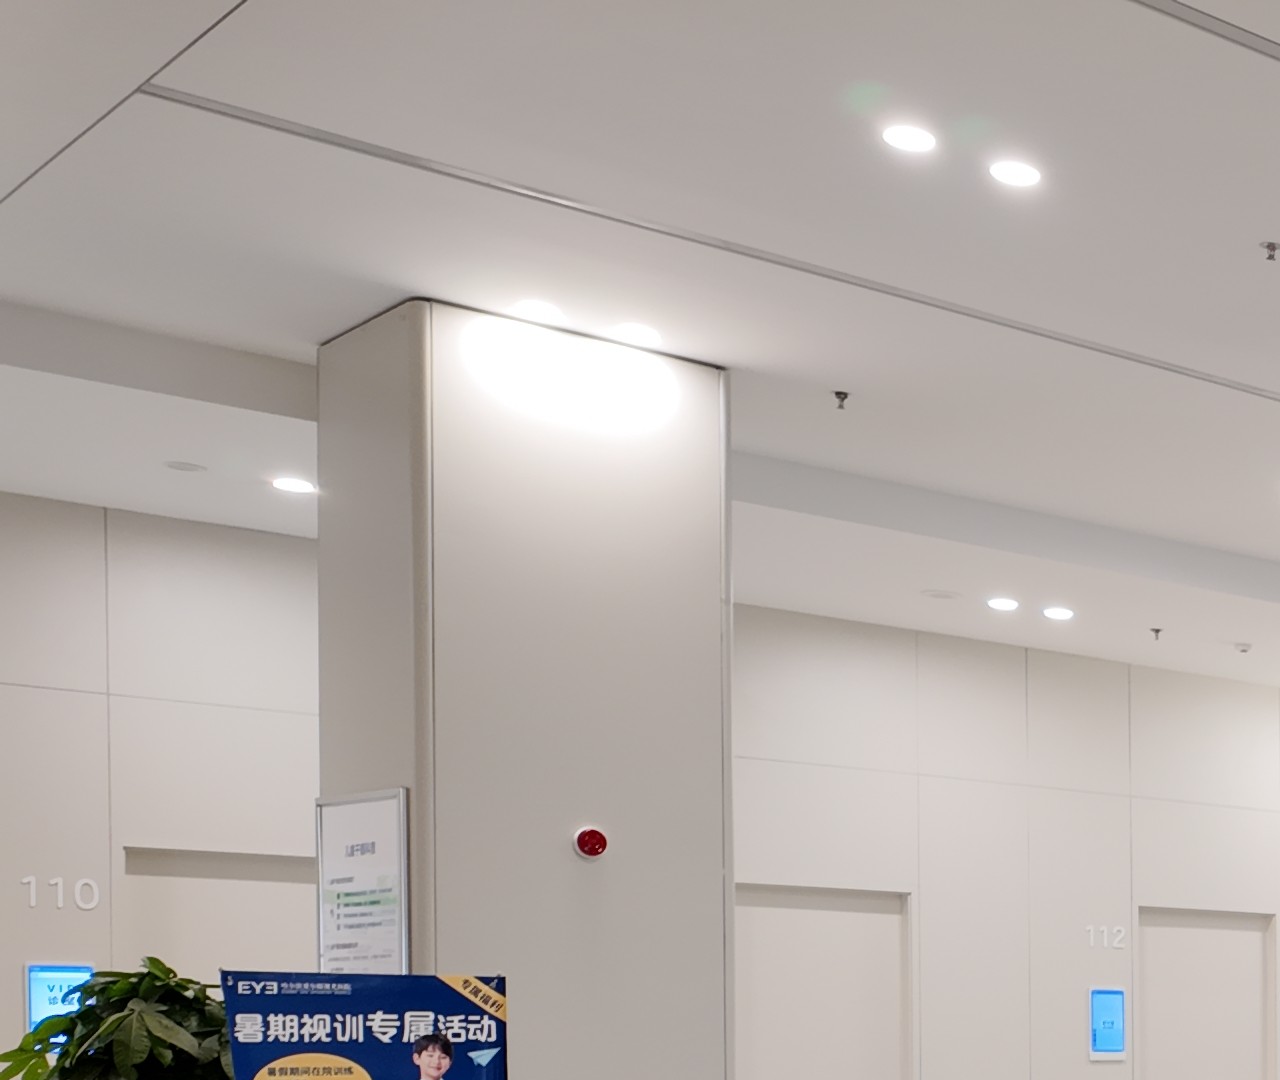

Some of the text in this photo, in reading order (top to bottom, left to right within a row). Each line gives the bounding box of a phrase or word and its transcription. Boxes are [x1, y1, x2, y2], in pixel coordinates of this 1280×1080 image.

[20, 875, 100, 911] 110
[1085, 924, 1126, 949] 112
[461, 978, 505, 1013] 专属福利
[233, 1010, 498, 1044] 暑期视训专属活动
[266, 1066, 355, 1077] 暑假期间在院训练
